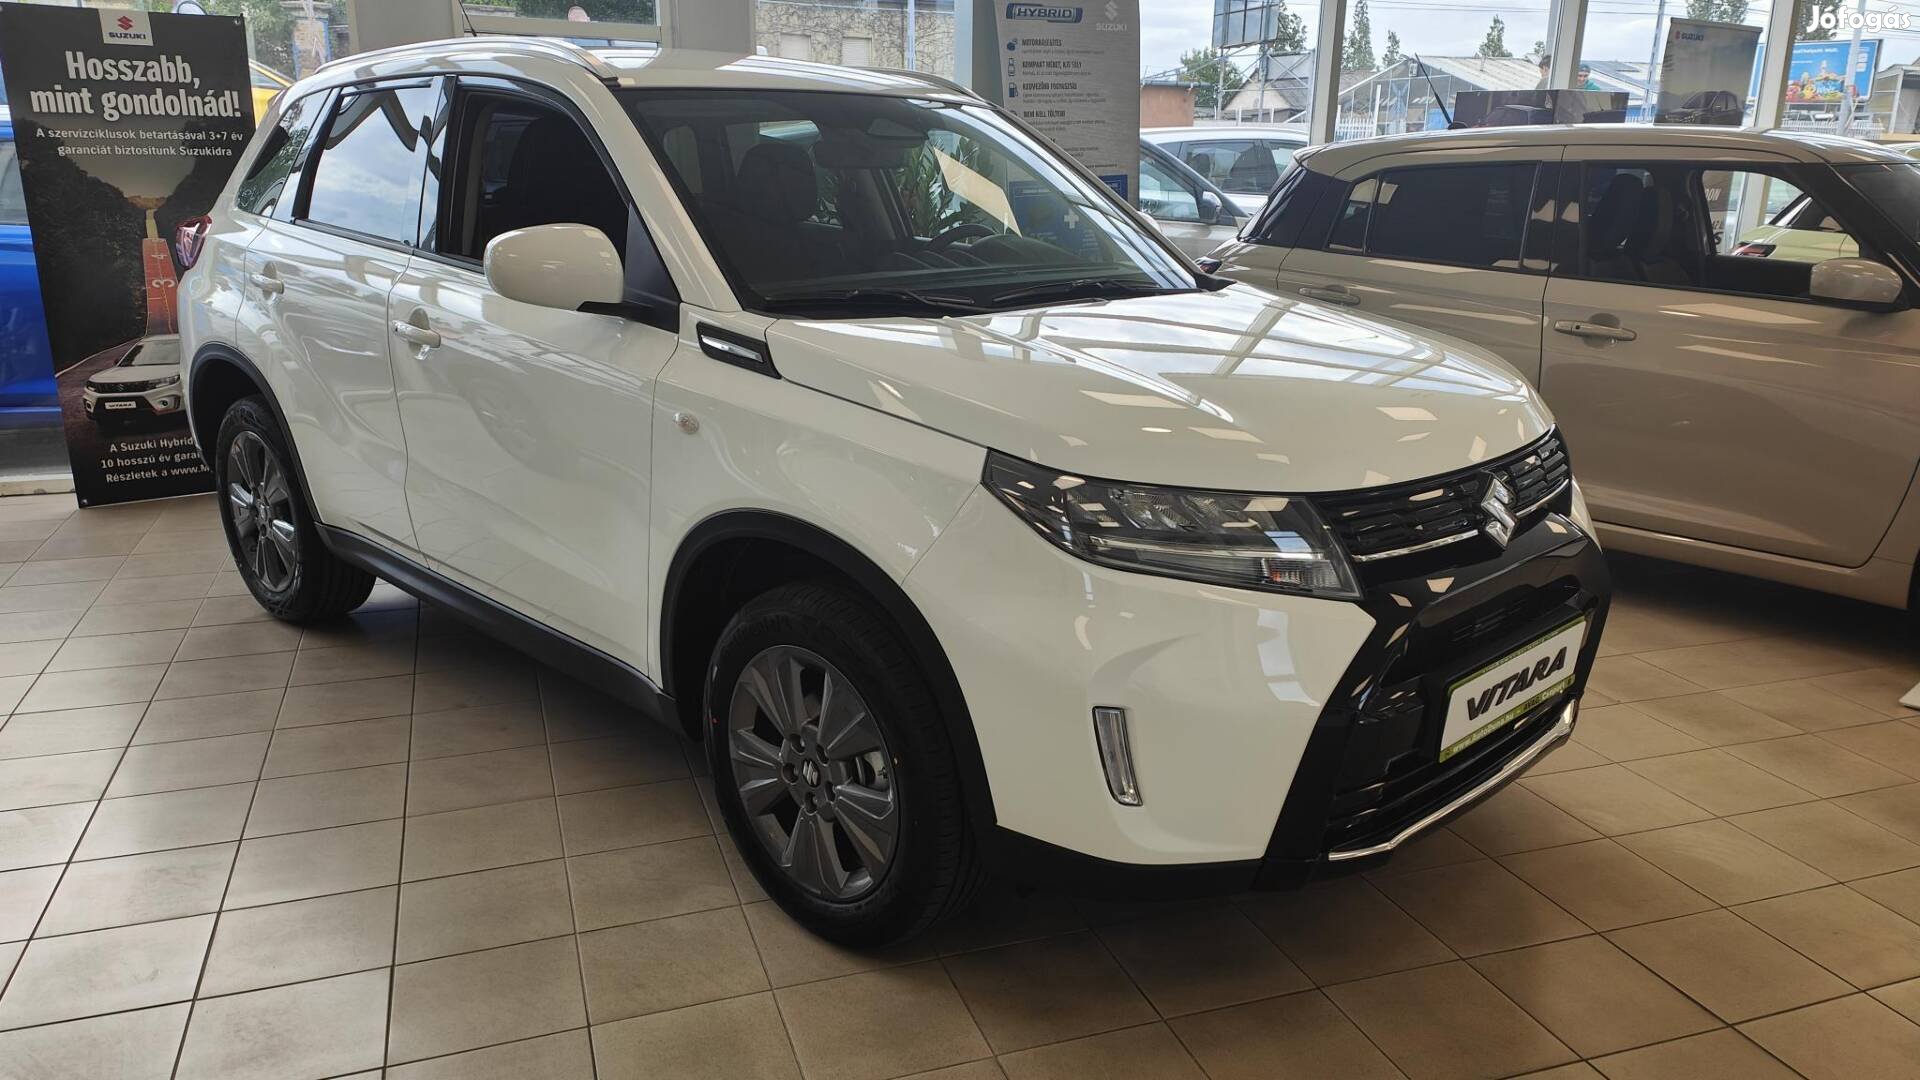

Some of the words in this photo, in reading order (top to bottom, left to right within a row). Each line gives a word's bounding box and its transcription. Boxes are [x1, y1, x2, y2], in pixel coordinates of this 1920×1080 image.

[1016, 8, 1072, 18] HYBRID
[1096, 23, 1127, 31] SUZUKI
[108, 31, 147, 40] SUZUKI
[65, 50, 200, 89] Hosszabb,
[30, 84, 95, 114] mint
[102, 88, 242, 121] gondolnád!
[36, 128, 45, 138] A
[140, 129, 206, 140] betartásával
[208, 131, 227, 140] 3+7
[231, 131, 243, 141] év
[57, 145, 112, 157] garanciát
[115, 145, 177, 156] biztosítunk
[179, 146, 233, 156] Suzukidra
[110, 443, 118, 453] A
[120, 440, 157, 452] Suzuki
[160, 437, 193, 449] Hybrid
[101, 459, 114, 469] 10
[116, 455, 156, 467] hosszú
[159, 454, 171, 463] év
[105, 469, 158, 483] Részletek
[1466, 646, 1567, 721] VITARA
